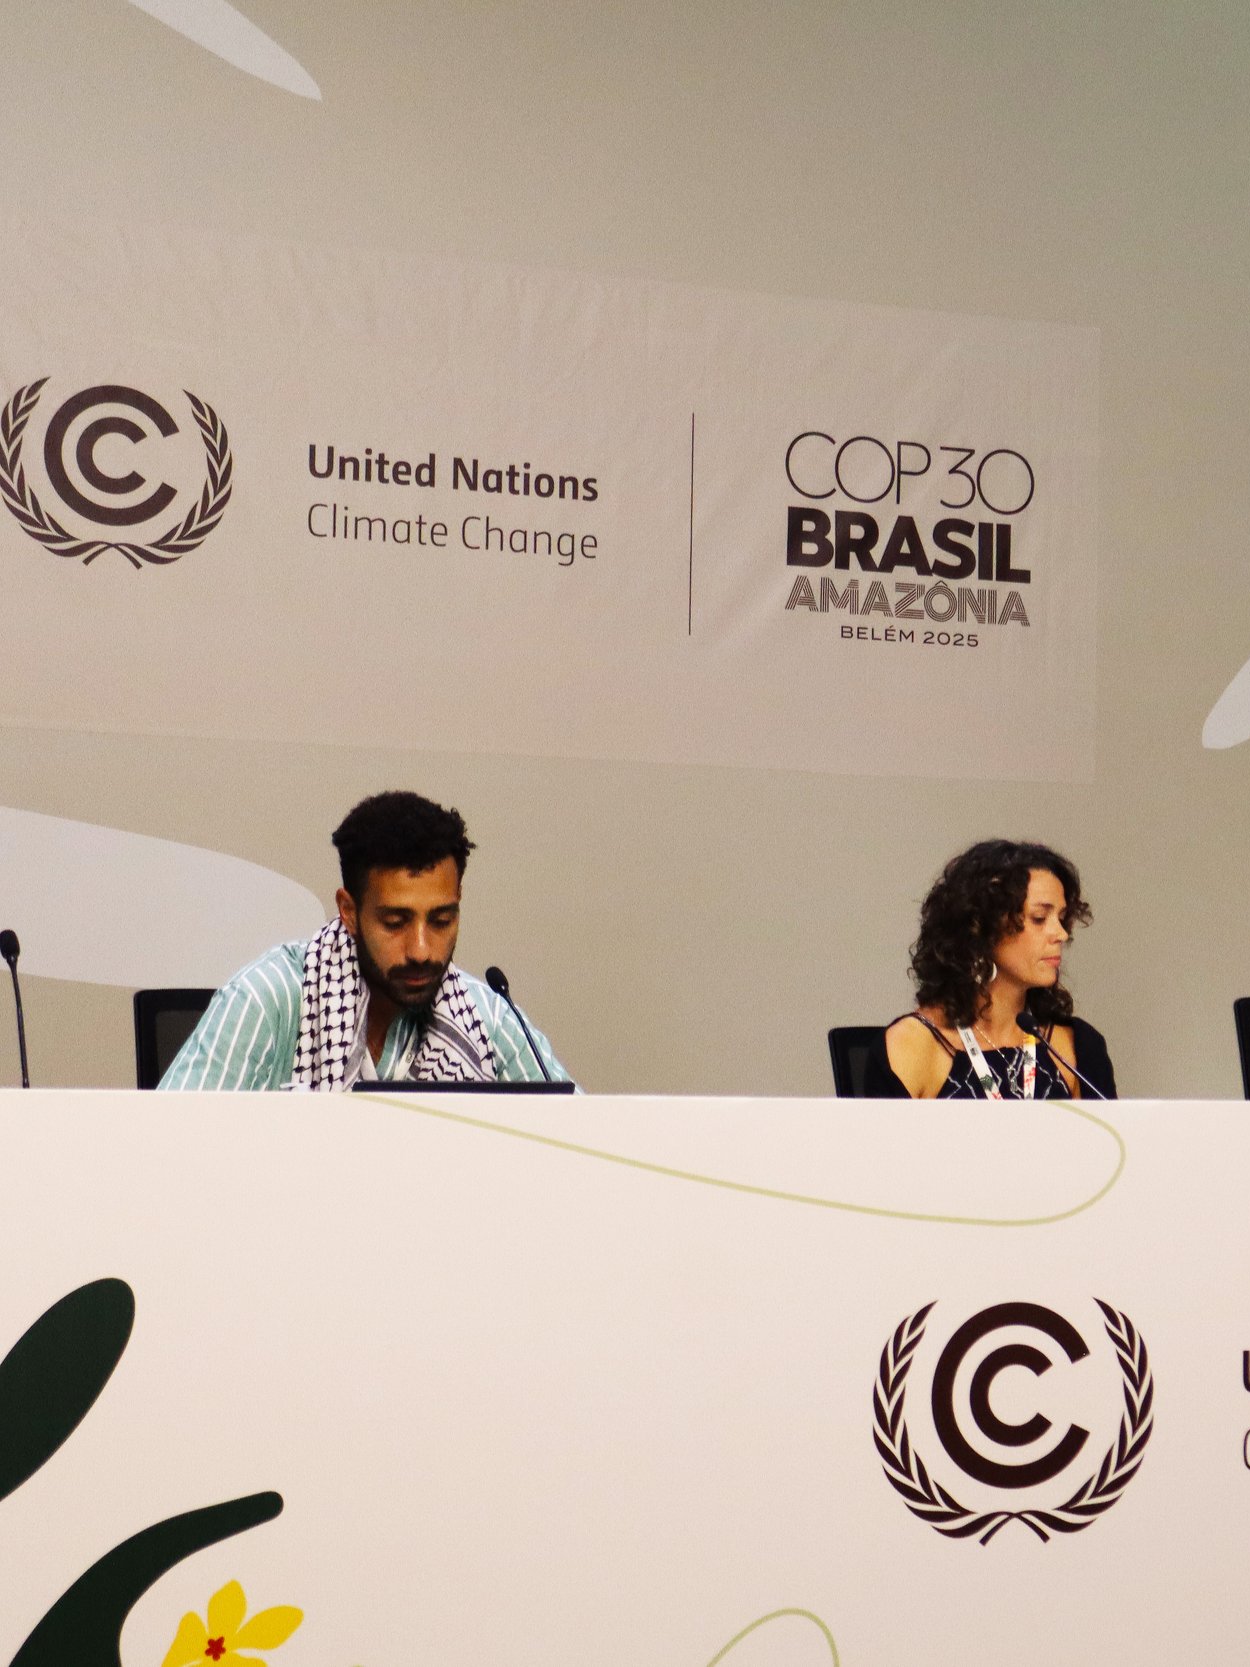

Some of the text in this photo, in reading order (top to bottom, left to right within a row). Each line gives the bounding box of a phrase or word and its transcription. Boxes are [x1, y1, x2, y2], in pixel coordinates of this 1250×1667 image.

[308, 443, 599, 503] United Nations
[785, 430, 1036, 516] COP30
[307, 502, 599, 568] Climate Change
[785, 505, 1032, 585] BRASIL
[784, 575, 1031, 627] AMAZÔNIA
[840, 624, 979, 648] BELÉM 2025
